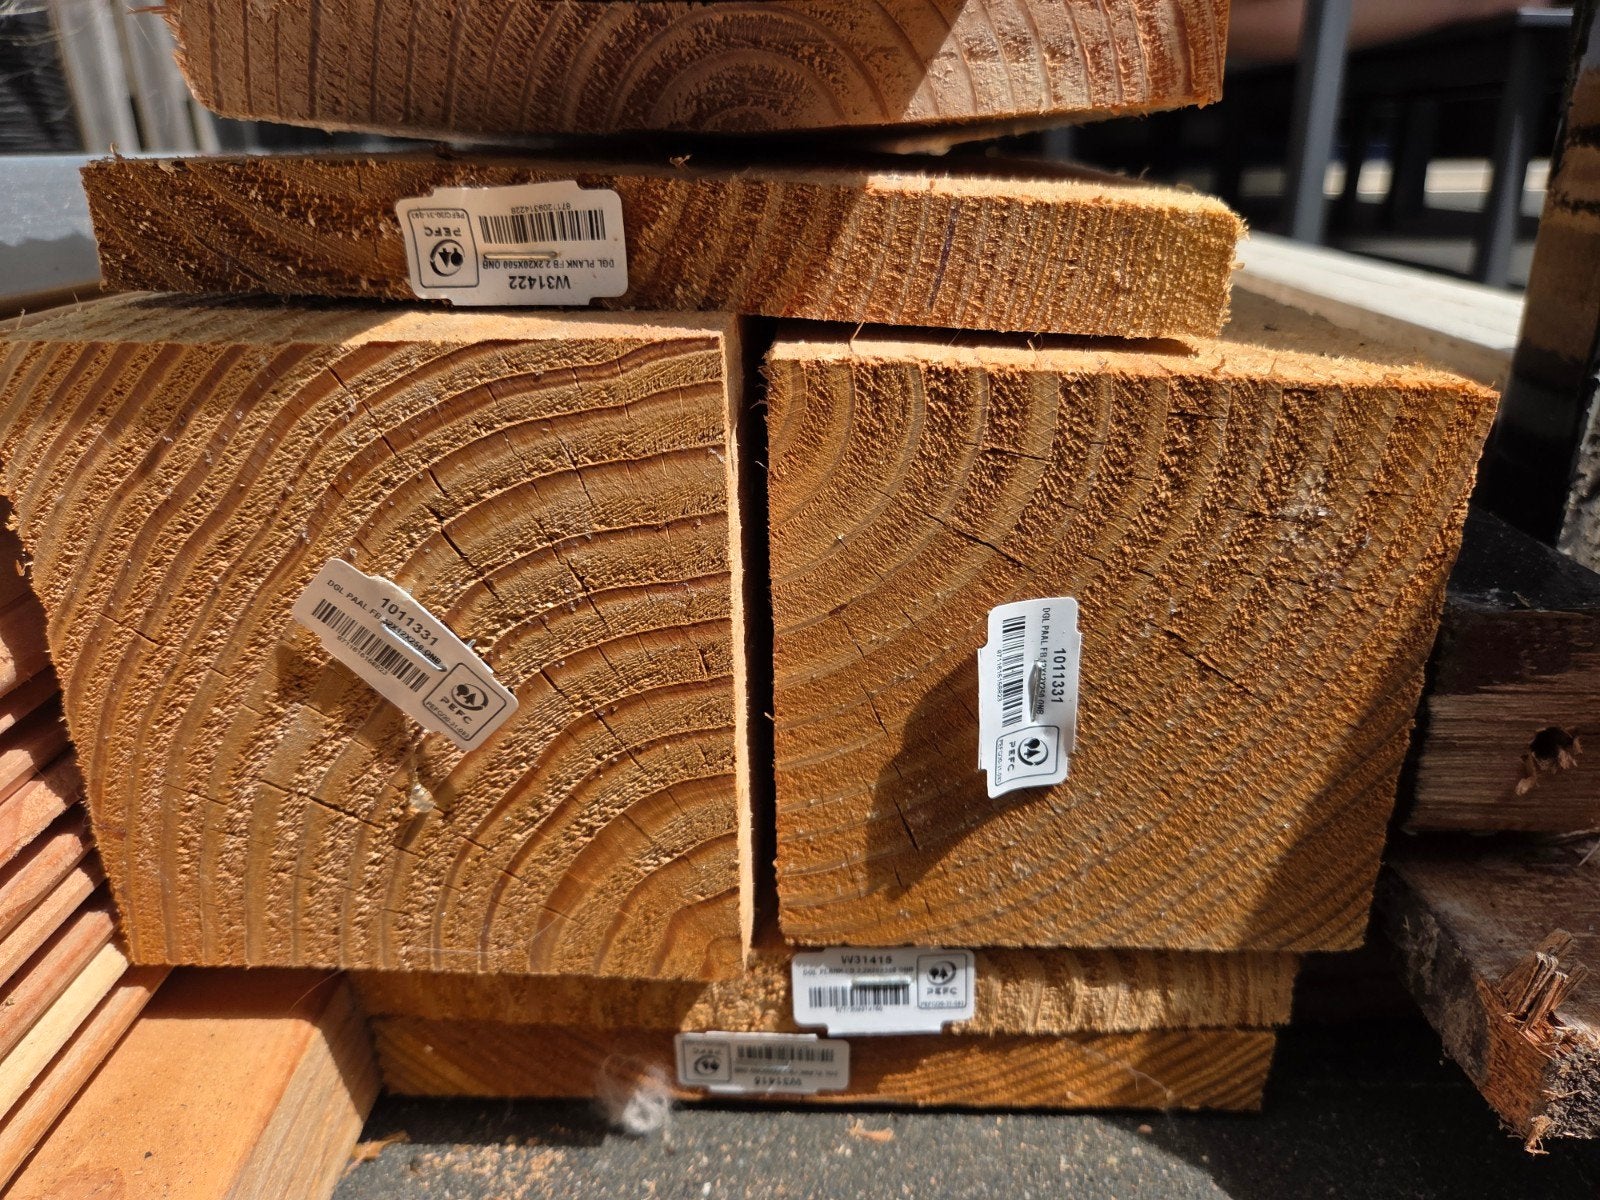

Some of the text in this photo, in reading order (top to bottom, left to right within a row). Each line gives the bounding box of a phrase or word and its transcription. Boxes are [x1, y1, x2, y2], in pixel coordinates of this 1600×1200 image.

[424, 227, 461, 236] PEFC
[482, 260, 501, 269] ONB
[566, 260, 594, 268] PLANK
[597, 259, 614, 268] DGL
[509, 276, 571, 289] W31422
[327, 579, 345, 595] DGL
[345, 592, 368, 611] PAAL
[368, 609, 382, 620] FB
[378, 596, 439, 647] 1011331
[1042, 608, 1050, 623] DGL
[1041, 626, 1049, 644] PAAL
[1040, 648, 1047, 657] FB
[1051, 648, 1066, 703] 1011331
[439, 696, 473, 725] PEFC
[927, 987, 957, 995] PEFC
